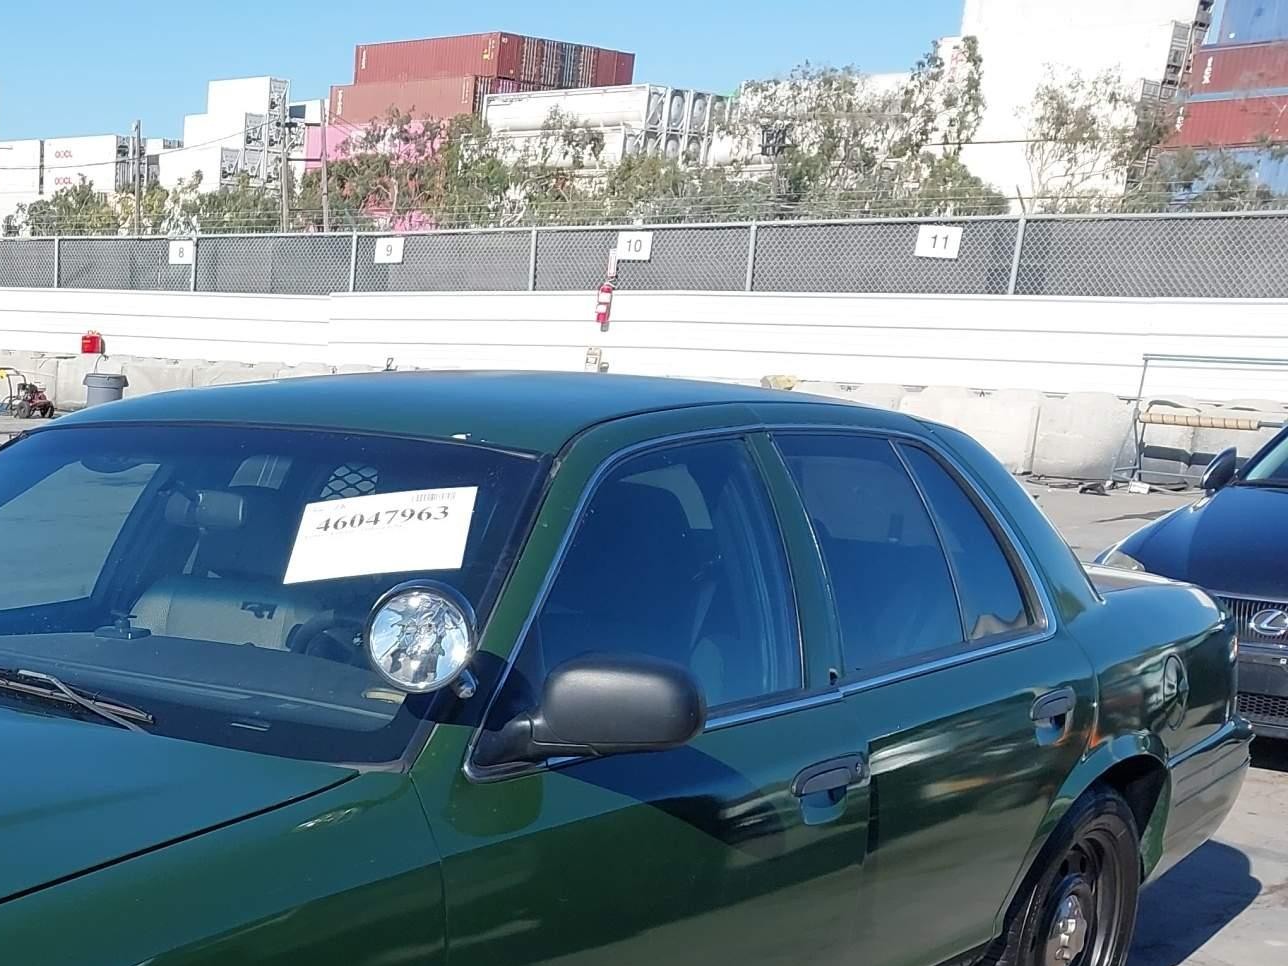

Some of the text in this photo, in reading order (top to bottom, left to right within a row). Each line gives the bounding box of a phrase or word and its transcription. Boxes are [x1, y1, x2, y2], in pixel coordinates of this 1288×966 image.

[626, 239, 643, 253] 10
[929, 234, 949, 250] 11
[178, 247, 185, 258] 8
[385, 244, 393, 257] 9
[316, 505, 449, 532] 46047963
